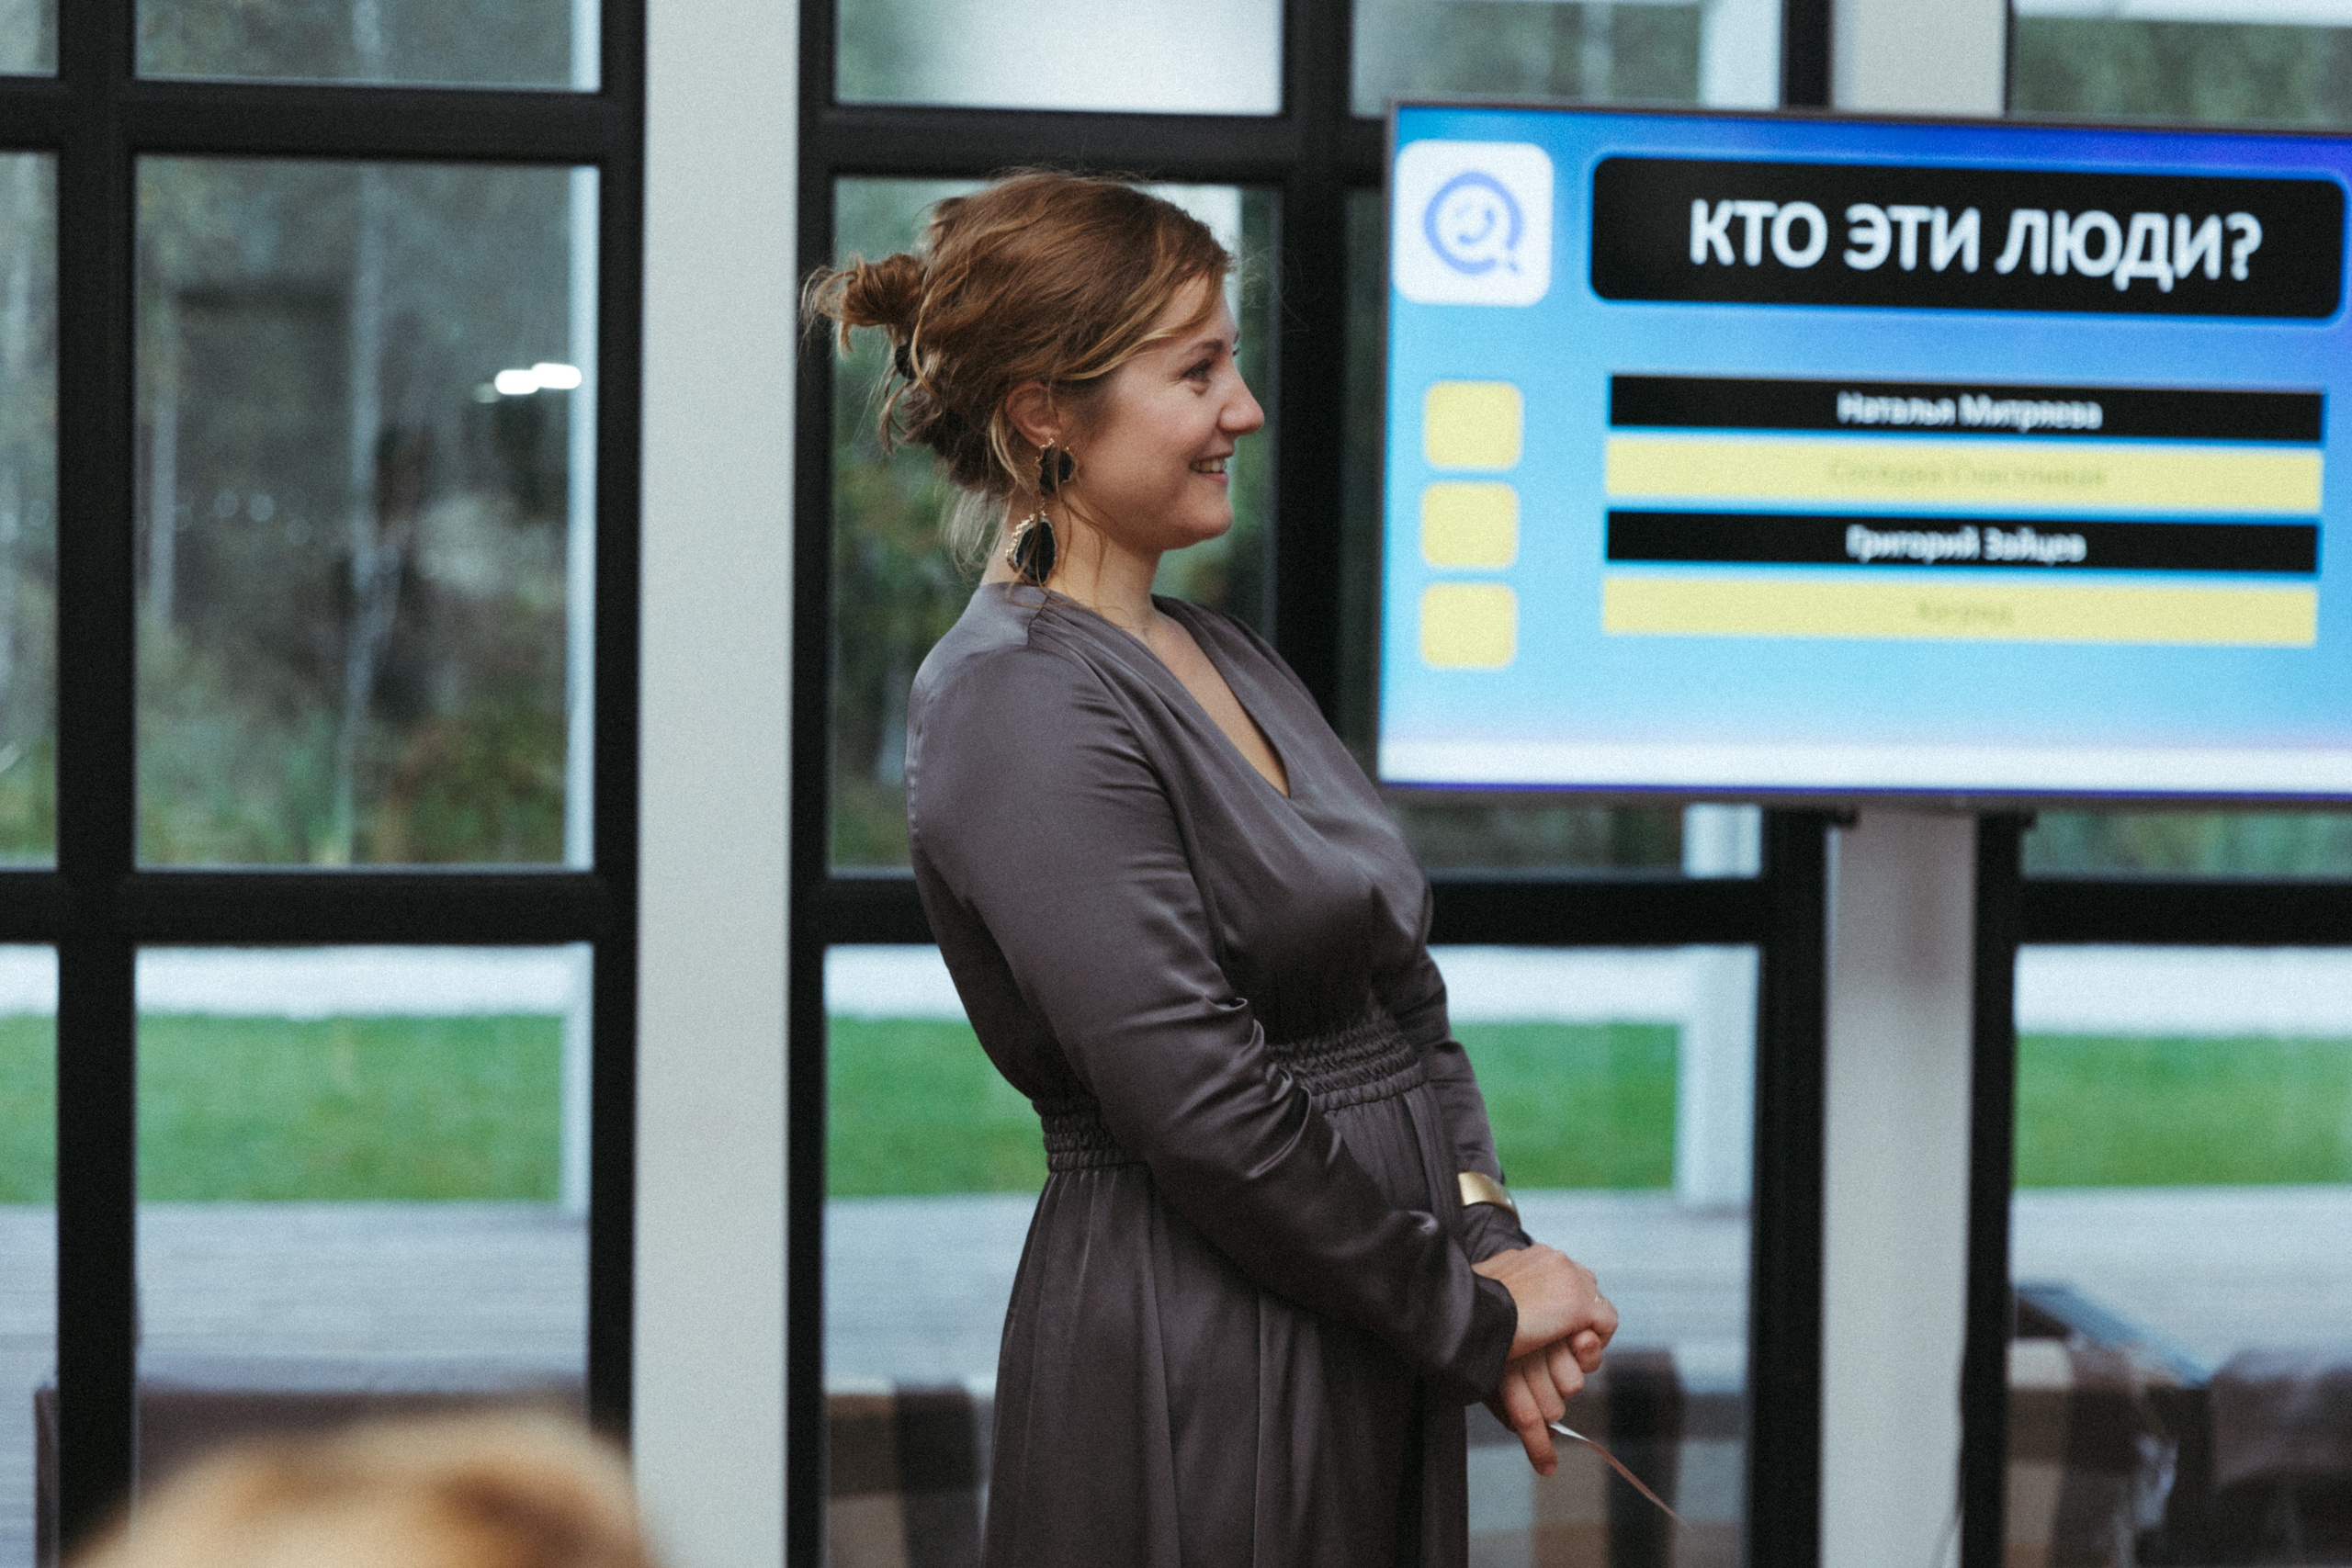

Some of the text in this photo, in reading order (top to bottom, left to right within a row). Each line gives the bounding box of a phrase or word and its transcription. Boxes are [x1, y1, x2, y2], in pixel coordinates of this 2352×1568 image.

[1690, 197, 2263, 293] КТО ЭТИ ЛЮДИ?
[1838, 390, 1956, 426] Наталья
[1846, 525, 1979, 565] Григорий
